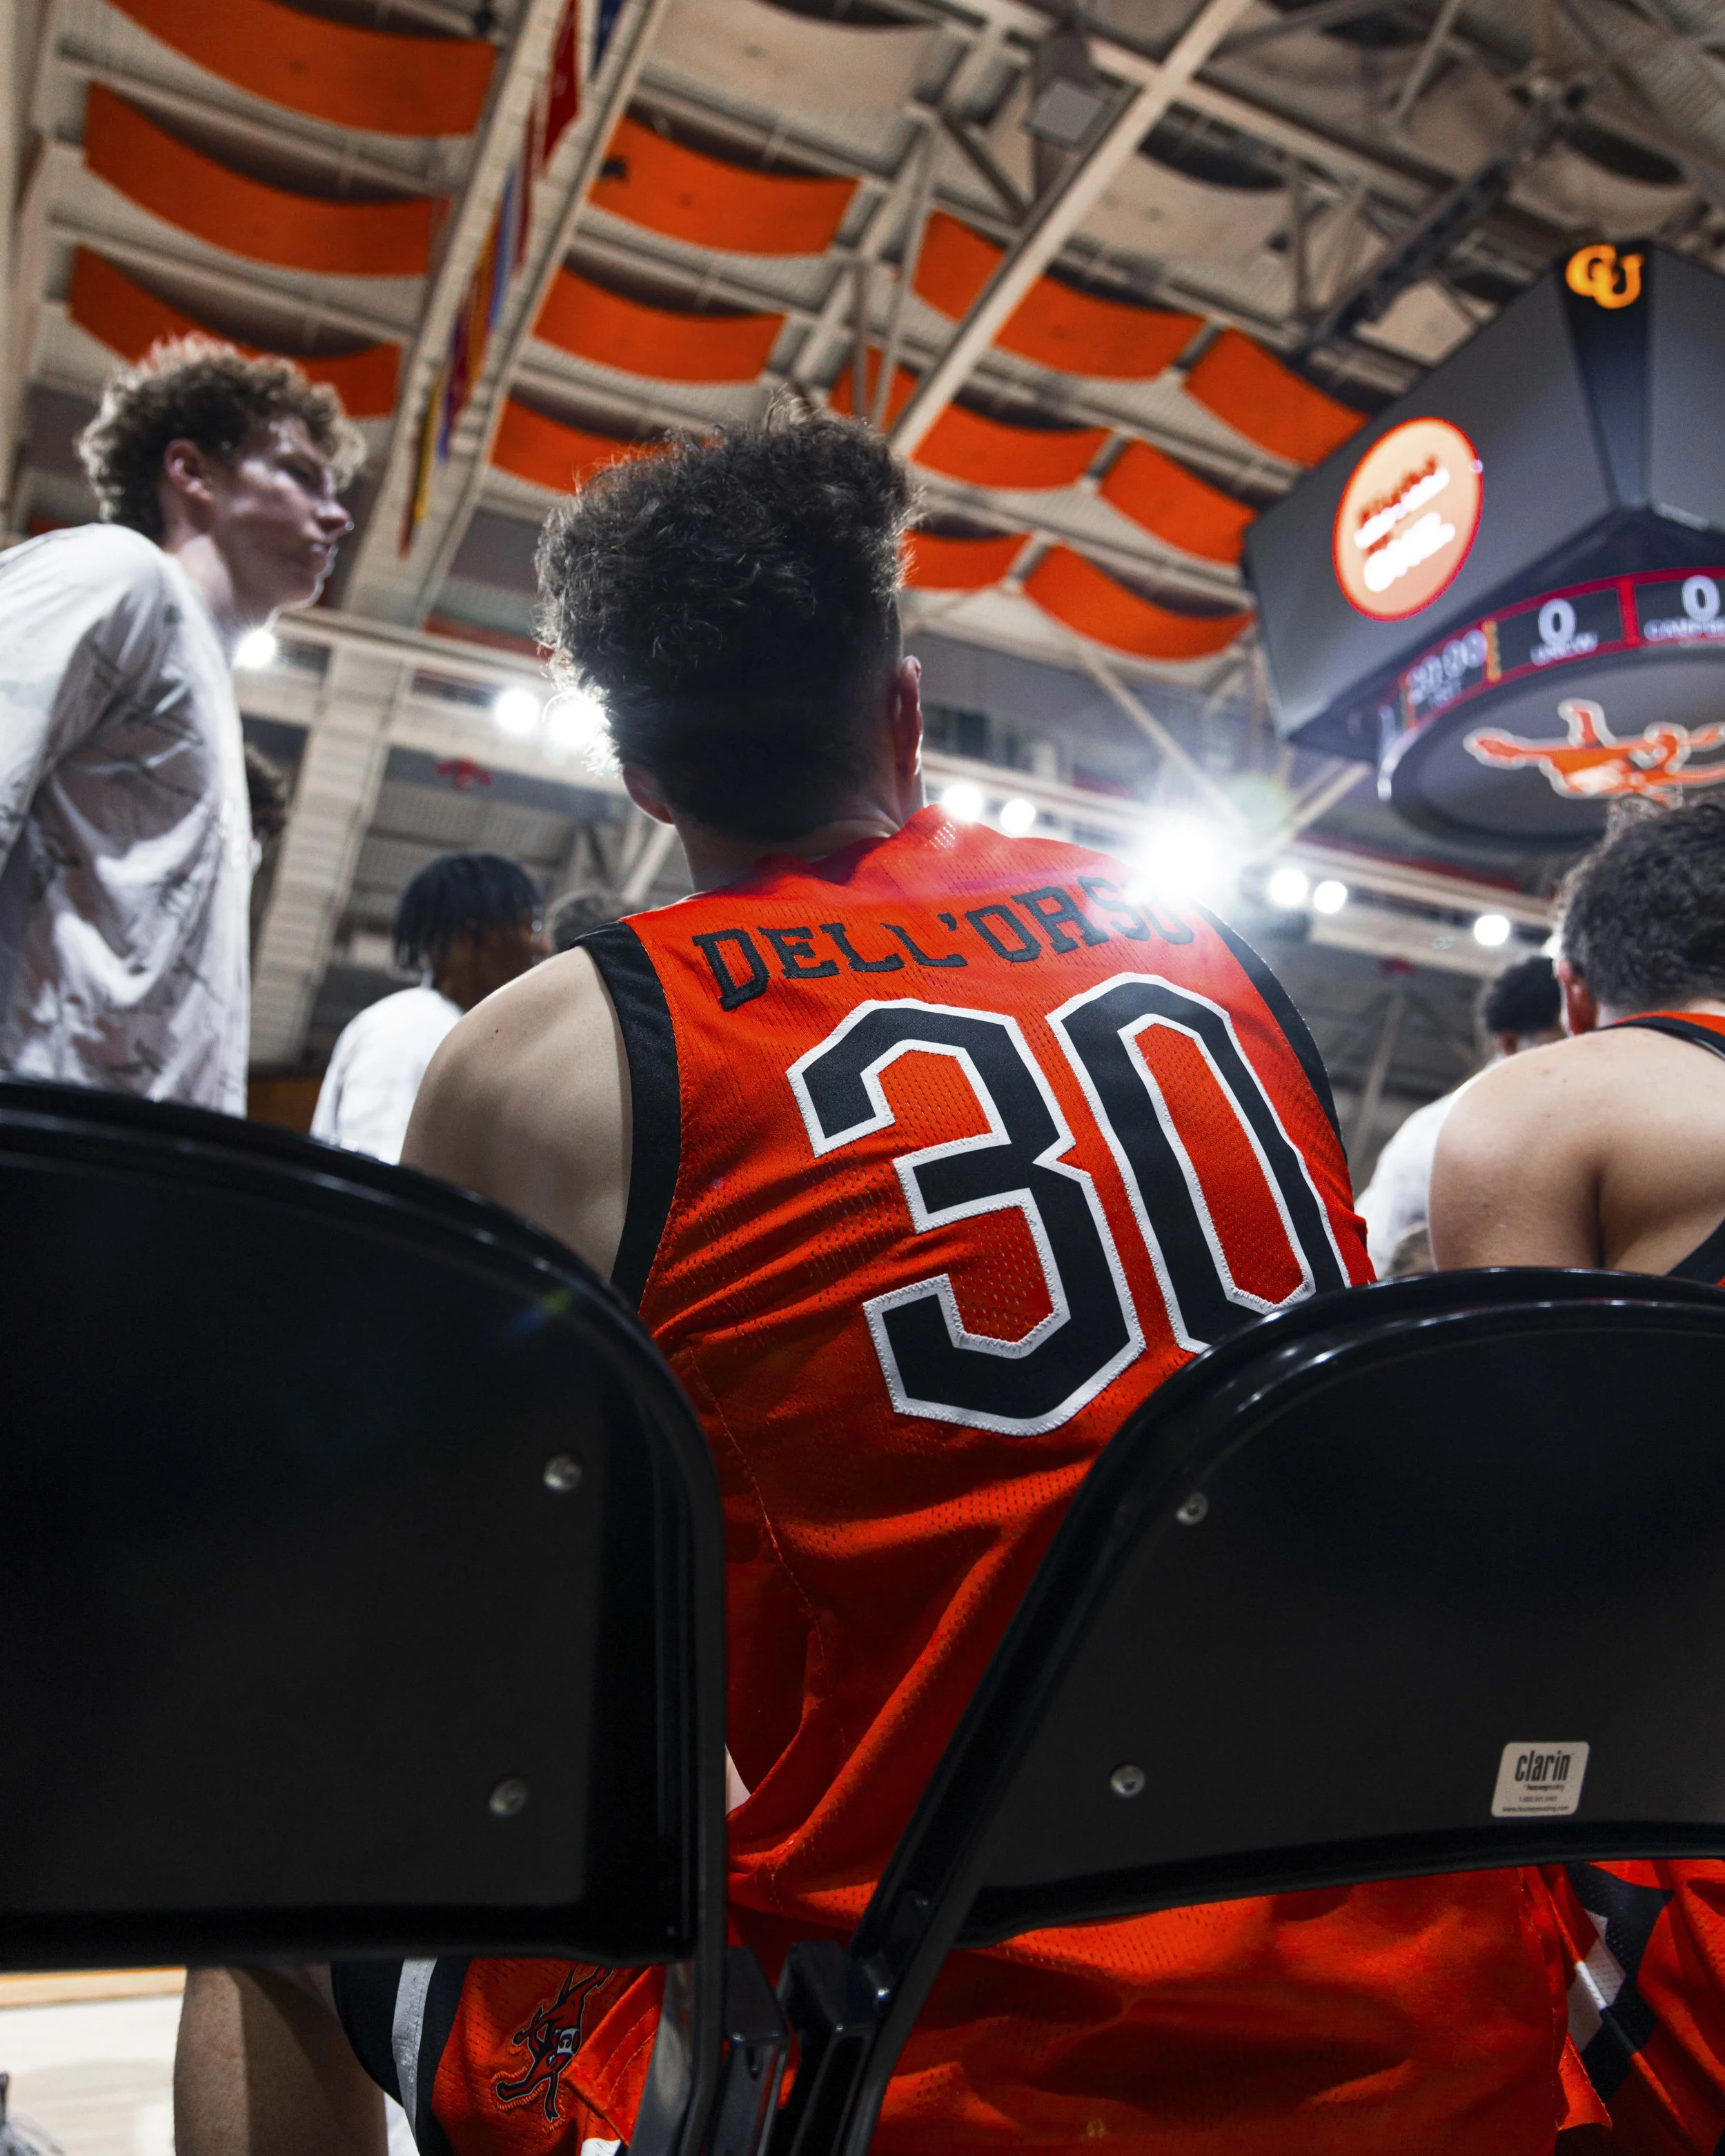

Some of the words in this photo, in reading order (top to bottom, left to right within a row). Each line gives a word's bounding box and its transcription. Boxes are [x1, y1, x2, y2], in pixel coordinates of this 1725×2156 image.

[1682, 575, 1720, 620] 0
[1538, 598, 1576, 646] 0
[692, 875, 1196, 1009] DELL'ORSO
[787, 972, 1351, 1437] 30
[1515, 1750, 1571, 1782] clarin
